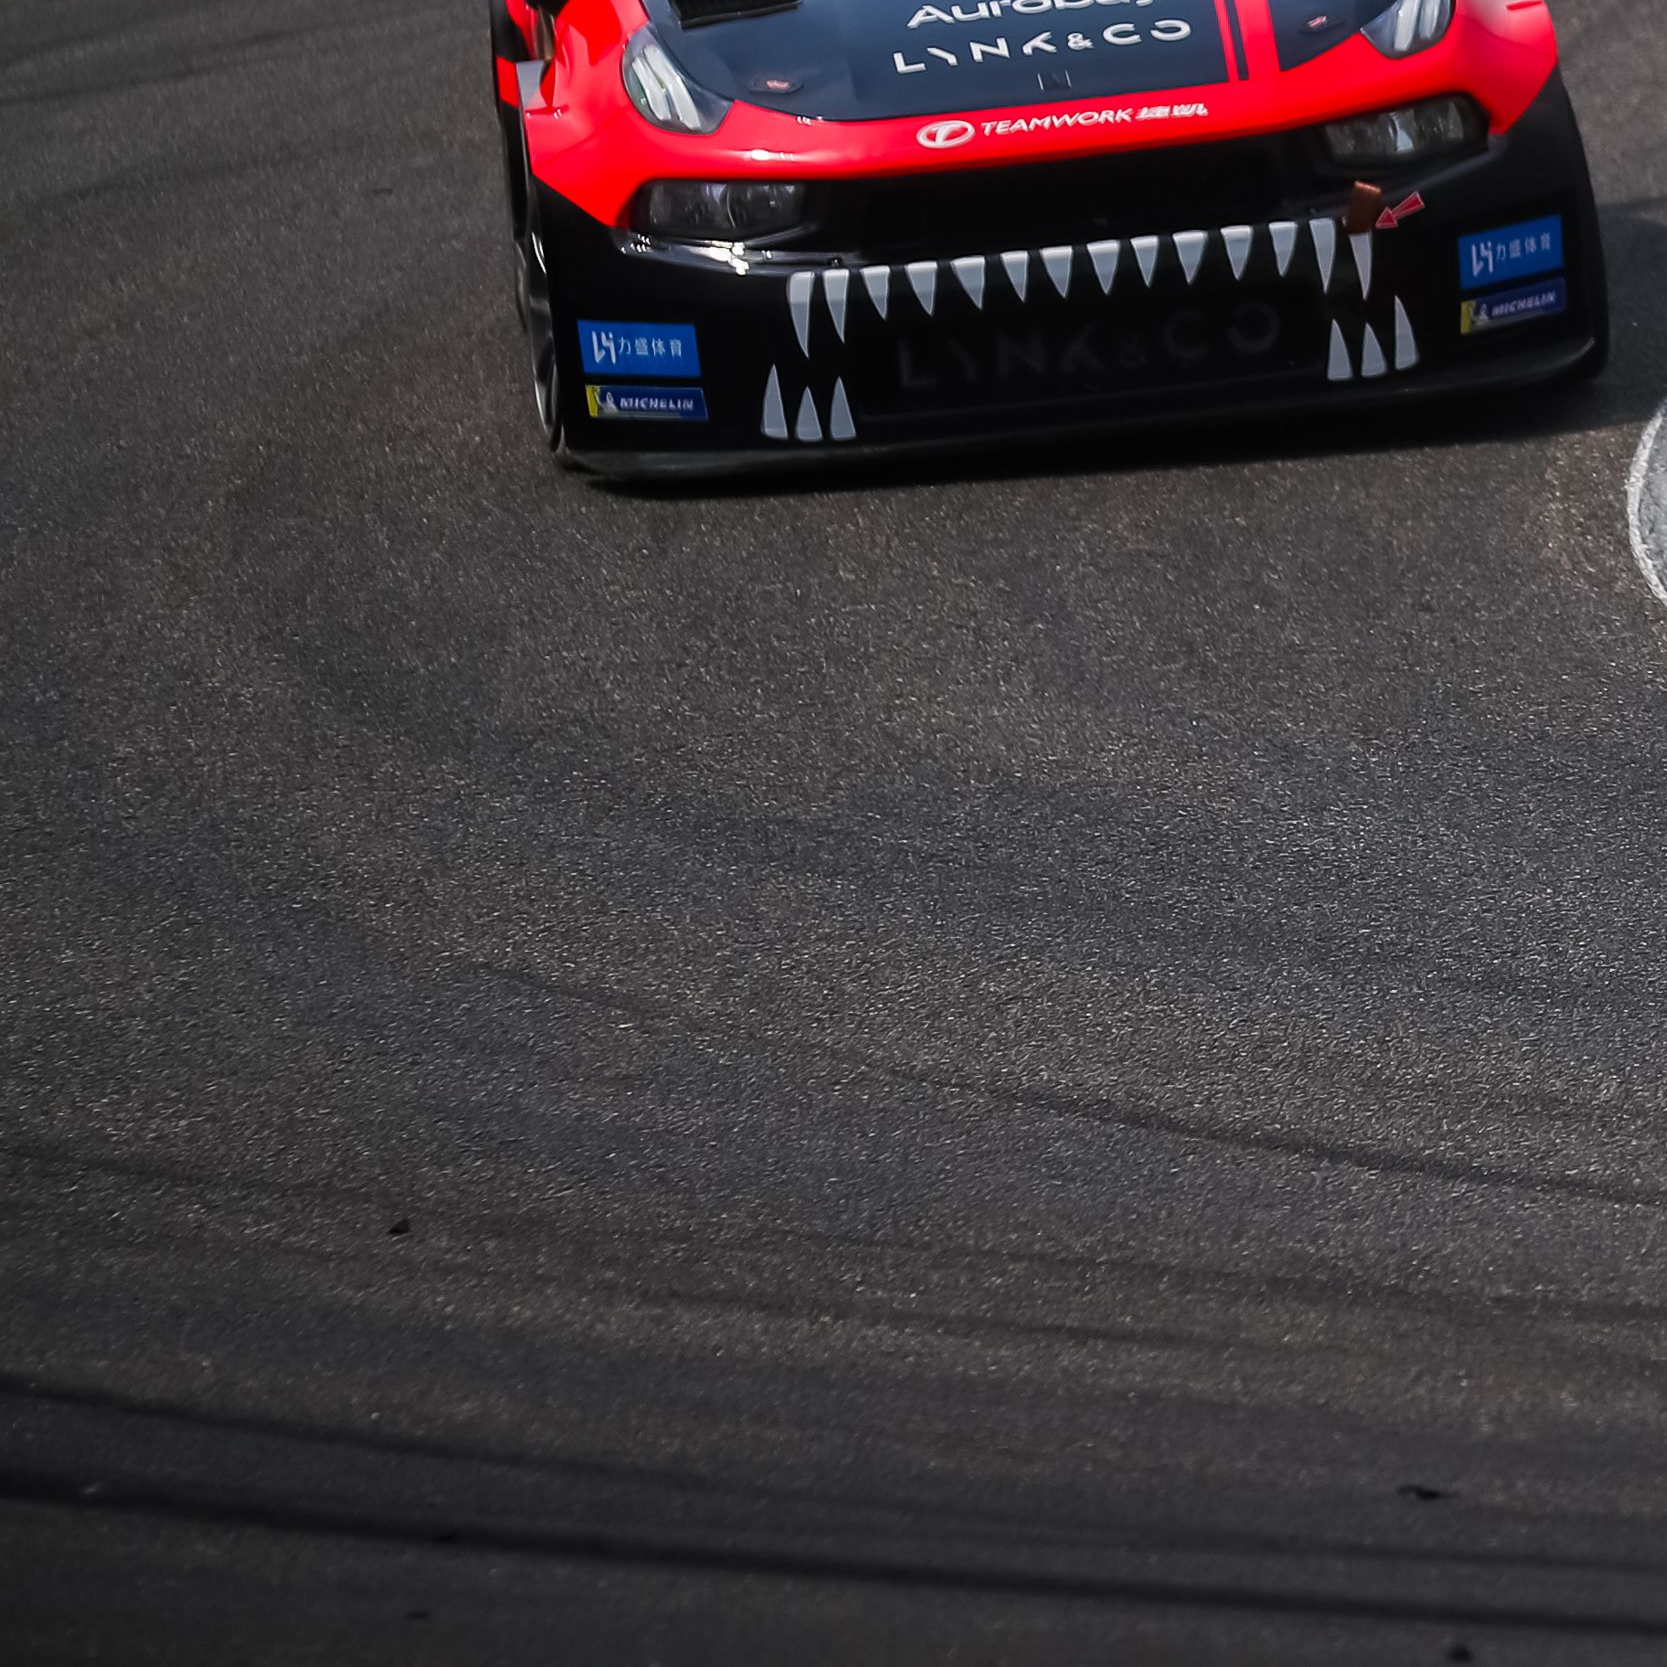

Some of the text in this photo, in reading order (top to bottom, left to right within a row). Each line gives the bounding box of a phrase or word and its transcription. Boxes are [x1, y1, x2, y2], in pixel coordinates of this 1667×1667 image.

[980, 107, 1132, 137] TEAMWORK
[1492, 290, 1556, 317] MICHELIN
[619, 336, 683, 358] 力盛体育
[620, 397, 694, 412] MICHELIN
